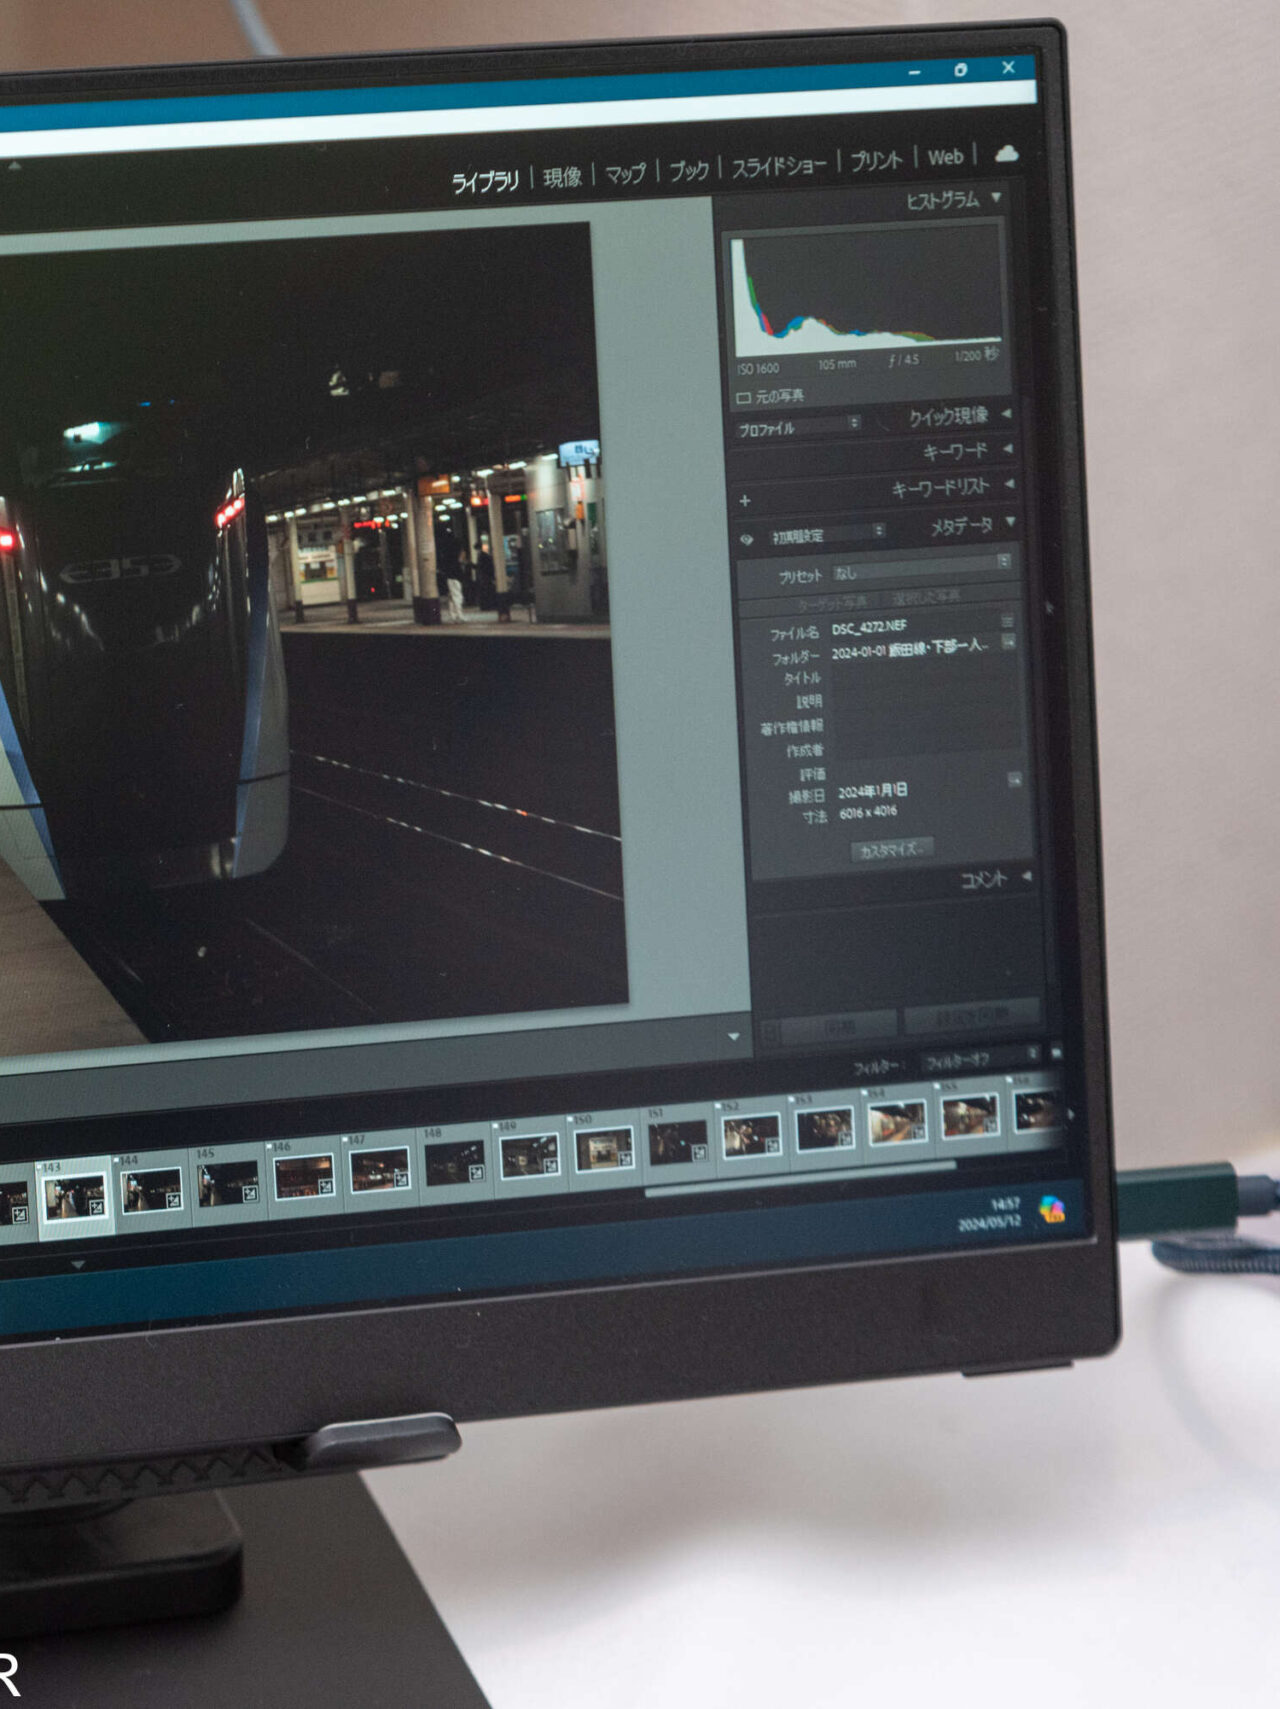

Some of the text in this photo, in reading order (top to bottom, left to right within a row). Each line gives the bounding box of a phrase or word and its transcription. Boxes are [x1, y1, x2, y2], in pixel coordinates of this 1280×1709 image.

[851, 150, 904, 173] プリント
[928, 148, 964, 166] Web
[605, 161, 648, 185] マップ
[670, 159, 710, 183] ブック
[732, 156, 828, 180] スライドショー
[452, 169, 520, 195] ライブラリ
[543, 166, 583, 189] 現像
[907, 189, 980, 211] ヒストグラム
[737, 362, 780, 376] ISO 1600
[819, 358, 858, 371] 105 mm
[756, 388, 805, 405] 元の写真
[910, 405, 990, 428] クイック現像
[739, 421, 796, 438] プロファイル
[923, 441, 988, 462] キーワード
[892, 477, 991, 499] キーワードリスト
[931, 517, 994, 538] メタデータ
[779, 568, 823, 585] プリセット
[835, 566, 857, 581] なし
[771, 626, 821, 642] ファイル名
[832, 619, 908, 637] DSC_4272.NEF
[773, 650, 820, 667] フォルダー
[832, 645, 887, 661] 2024-01-01
[784, 670, 822, 686] タイトル
[838, 781, 908, 800] 2024年1月1日
[802, 809, 828, 825] 寸法
[840, 804, 898, 820] 6016 4016
[962, 869, 1008, 890] コメント
[348, 1134, 366, 1146] 147
[424, 1127, 442, 1139] 148
[196, 1146, 215, 1159] 145
[272, 1140, 292, 1152] 146
[42, 1161, 61, 1173] 143
[119, 1154, 139, 1166] 144
